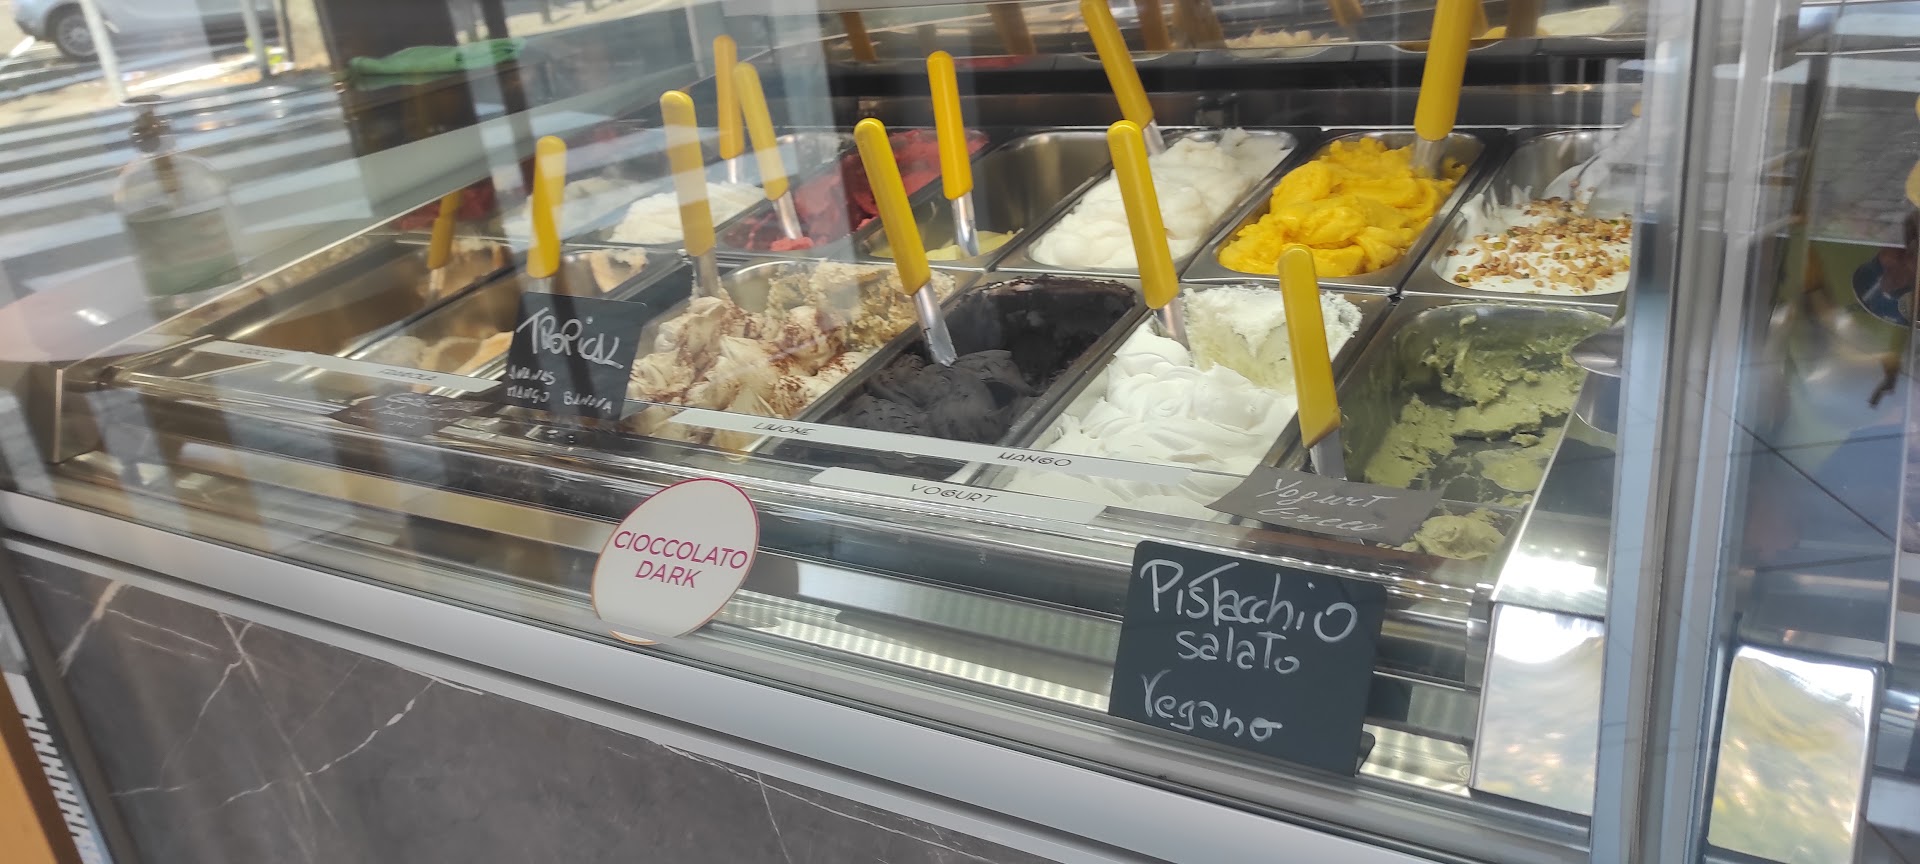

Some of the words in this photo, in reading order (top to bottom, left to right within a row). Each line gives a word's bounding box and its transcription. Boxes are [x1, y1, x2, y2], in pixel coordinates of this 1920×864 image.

[506, 384, 551, 404] MANGO
[753, 422, 817, 436] LIMONE
[997, 452, 1072, 467] MANGO
[910, 483, 999, 503] YOGURT
[614, 530, 748, 569] CIOCCOLATO
[634, 560, 703, 589] DARK
